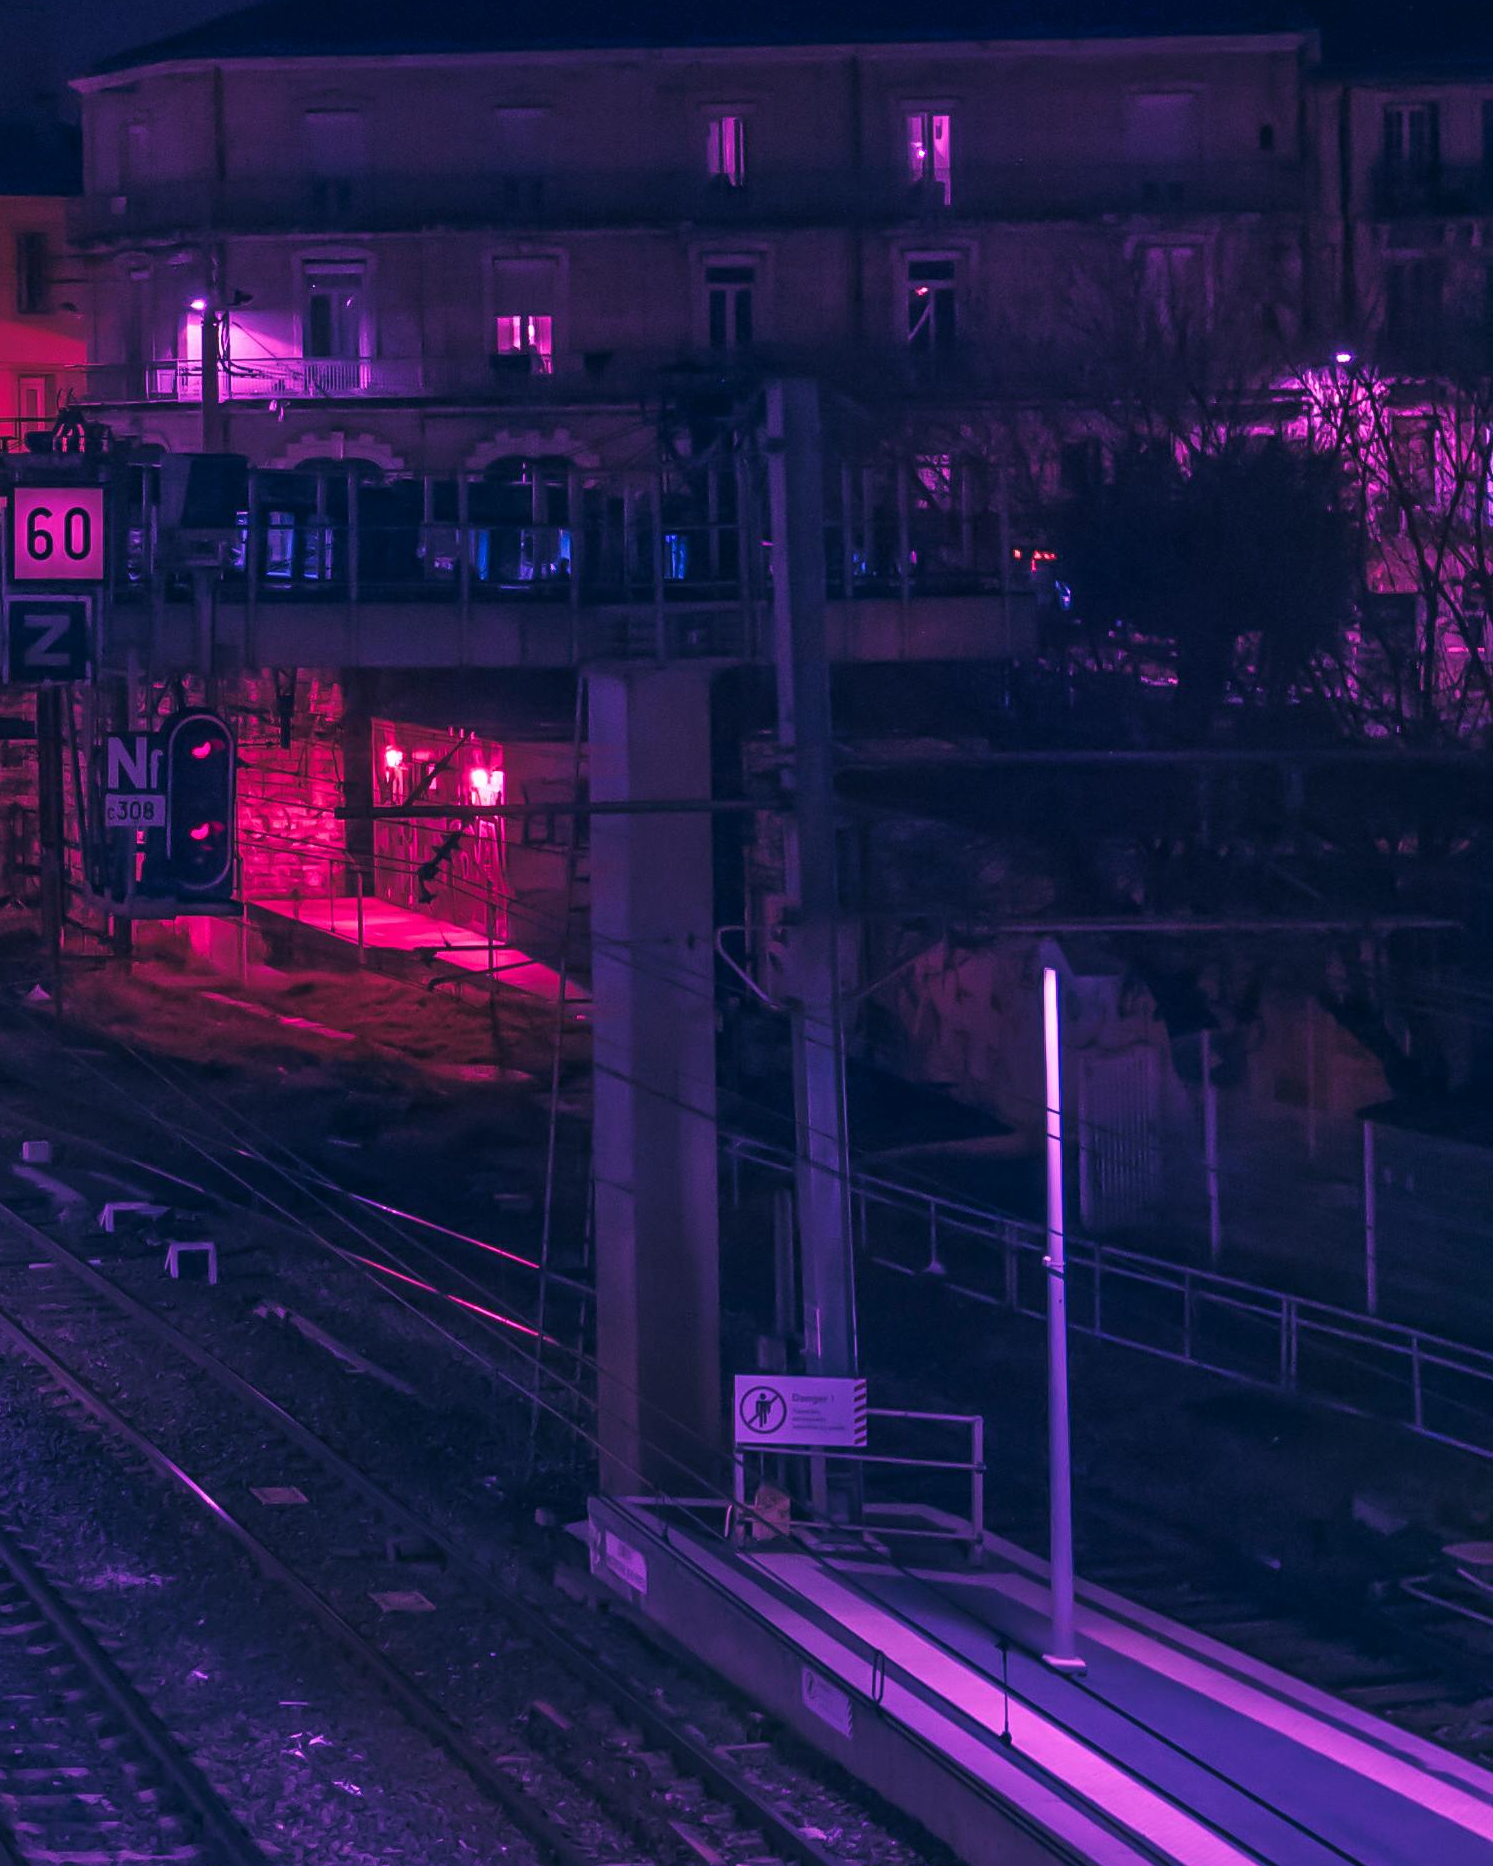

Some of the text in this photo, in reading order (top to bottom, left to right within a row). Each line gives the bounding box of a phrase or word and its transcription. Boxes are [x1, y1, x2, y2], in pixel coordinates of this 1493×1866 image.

[27, 506, 91, 560] 60
[24, 614, 71, 667] Z
[791, 1393, 829, 1405] Danger
